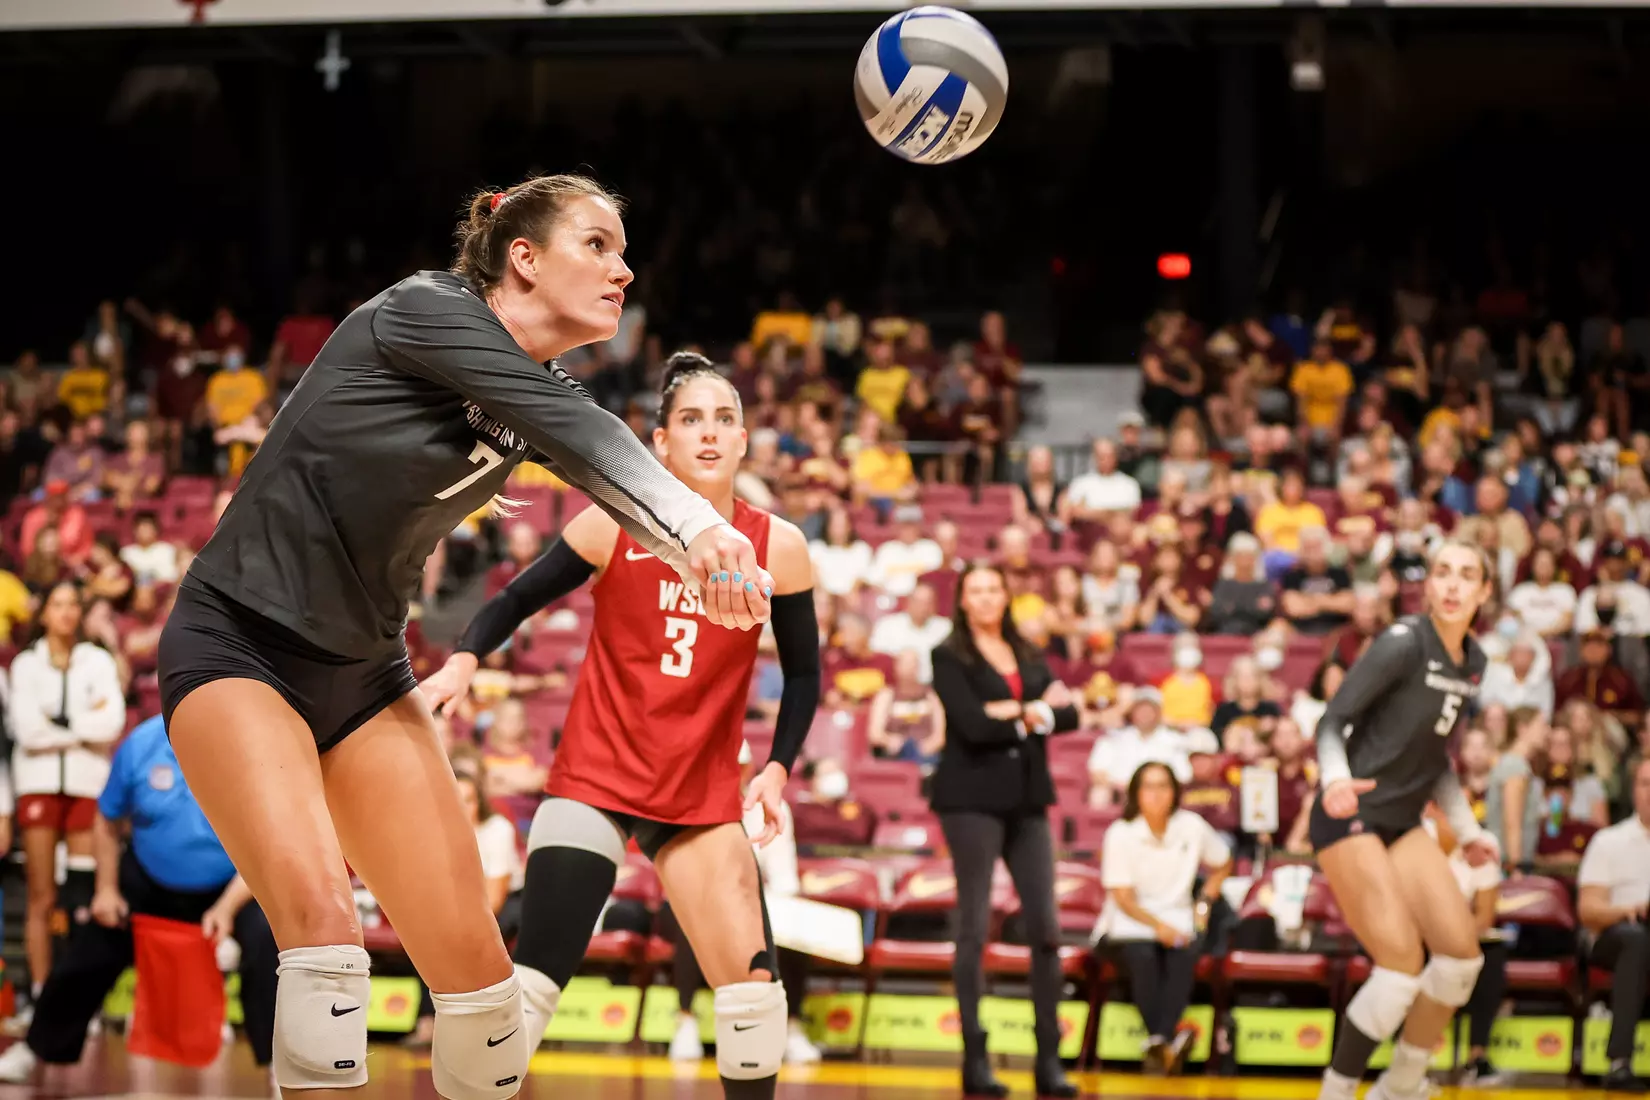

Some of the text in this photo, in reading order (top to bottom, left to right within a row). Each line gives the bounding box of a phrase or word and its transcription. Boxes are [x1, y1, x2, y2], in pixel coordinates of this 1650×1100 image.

[434, 439, 505, 500] 7
[659, 580, 707, 616] WS
[660, 616, 698, 678] 3
[1434, 693, 1462, 736] 5
